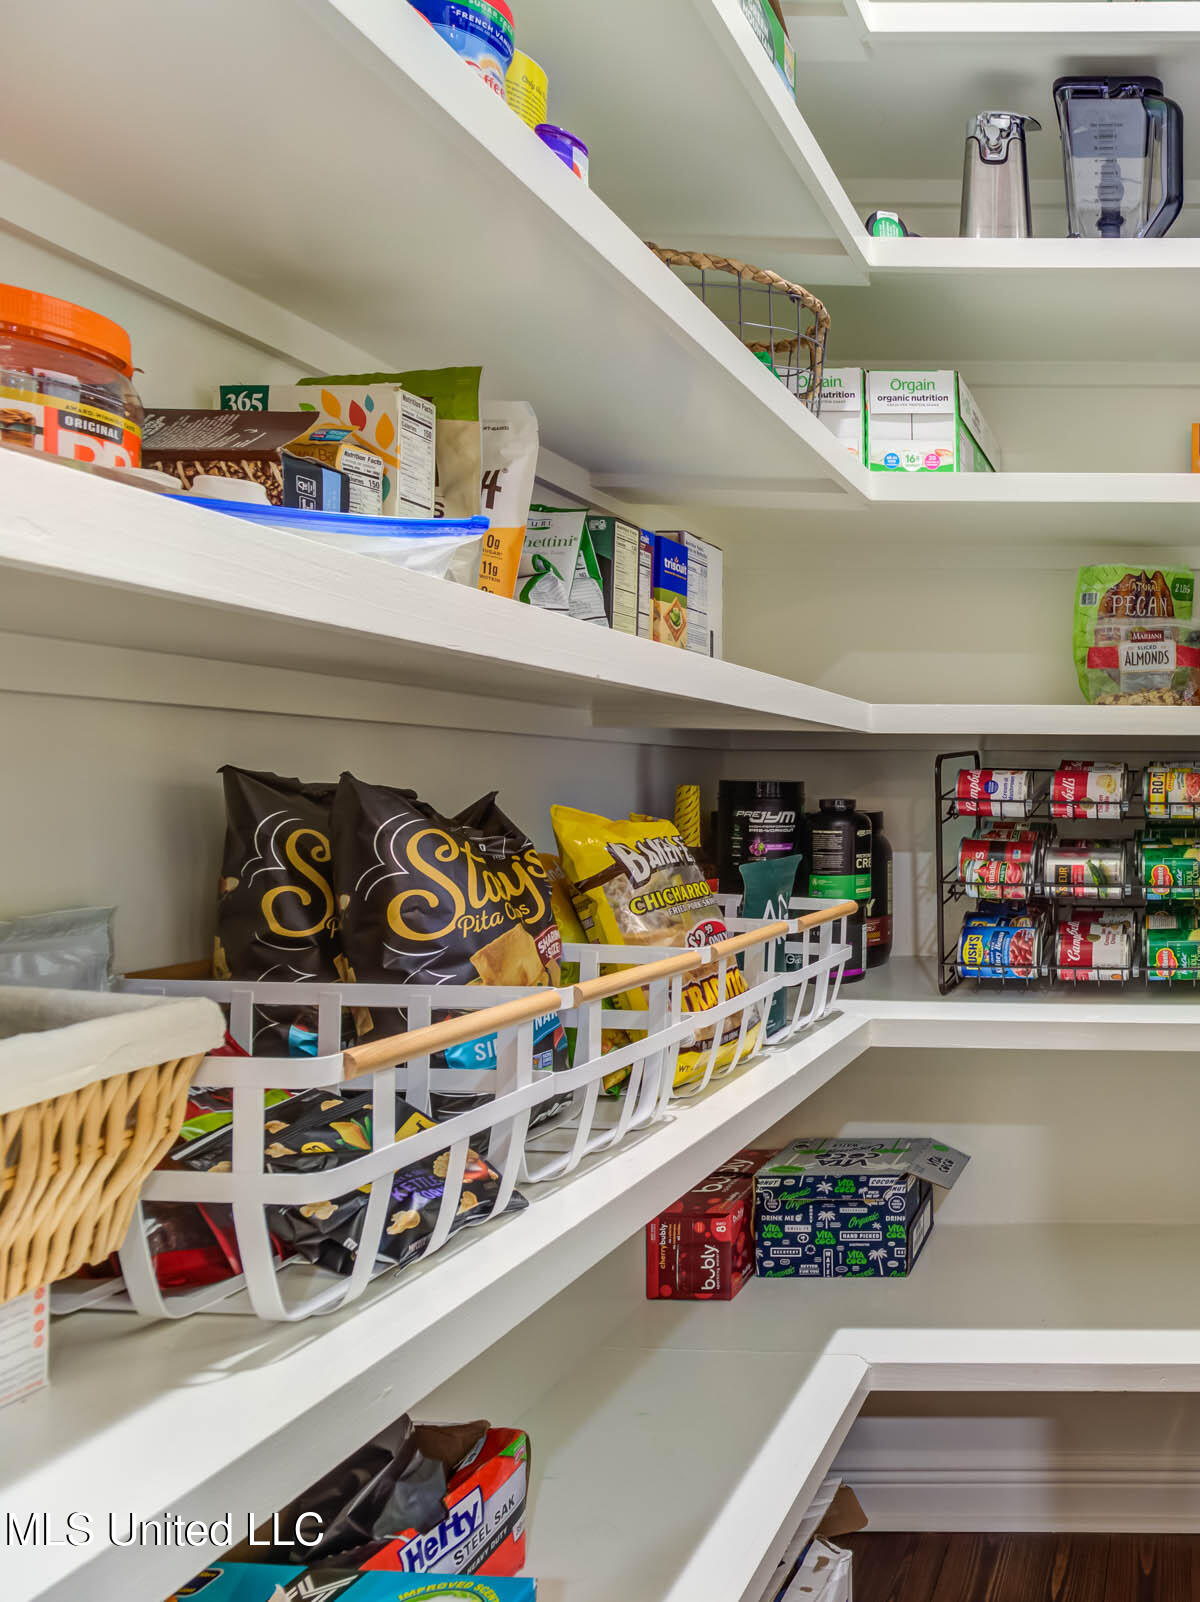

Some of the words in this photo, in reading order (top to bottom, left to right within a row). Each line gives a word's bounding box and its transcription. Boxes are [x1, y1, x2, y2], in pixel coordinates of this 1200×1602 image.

[455, 9, 494, 33] FRENCH
[890, 378, 936, 394] Orgain
[225, 391, 264, 411] 365
[877, 394, 910, 403] organic
[911, 393, 949, 402] nutrition
[64, 415, 120, 440] ORIGINAL
[343, 450, 366, 463] Nutrition
[367, 456, 383, 466] Facts
[368, 480, 380, 490] 150
[486, 534, 501, 550] 0g
[481, 561, 498, 577] 11g
[663, 556, 688, 574] triscuit
[1111, 595, 1168, 617] PECAN
[1124, 650, 1170, 667] ALMONDS
[629, 880, 711, 916] CHICHARRO
[457, 911, 505, 939] Pita
[716, 1225, 726, 1233] 8
[762, 1231, 784, 1239] COCO
[763, 1224, 781, 1232] VITA
[816, 1230, 834, 1239] VITA
[815, 1237, 837, 1245] COCO
[846, 1257, 867, 1265] COCO
[847, 1249, 865, 1258] VITA
[701, 1244, 719, 1290] bubly
[404, 1500, 479, 1574] Hefty
[453, 1522, 492, 1566] STEEL
[494, 1494, 516, 1526] SAK
[490, 1527, 508, 1551] DUTY
[398, 1581, 475, 1601] IMPROVED
